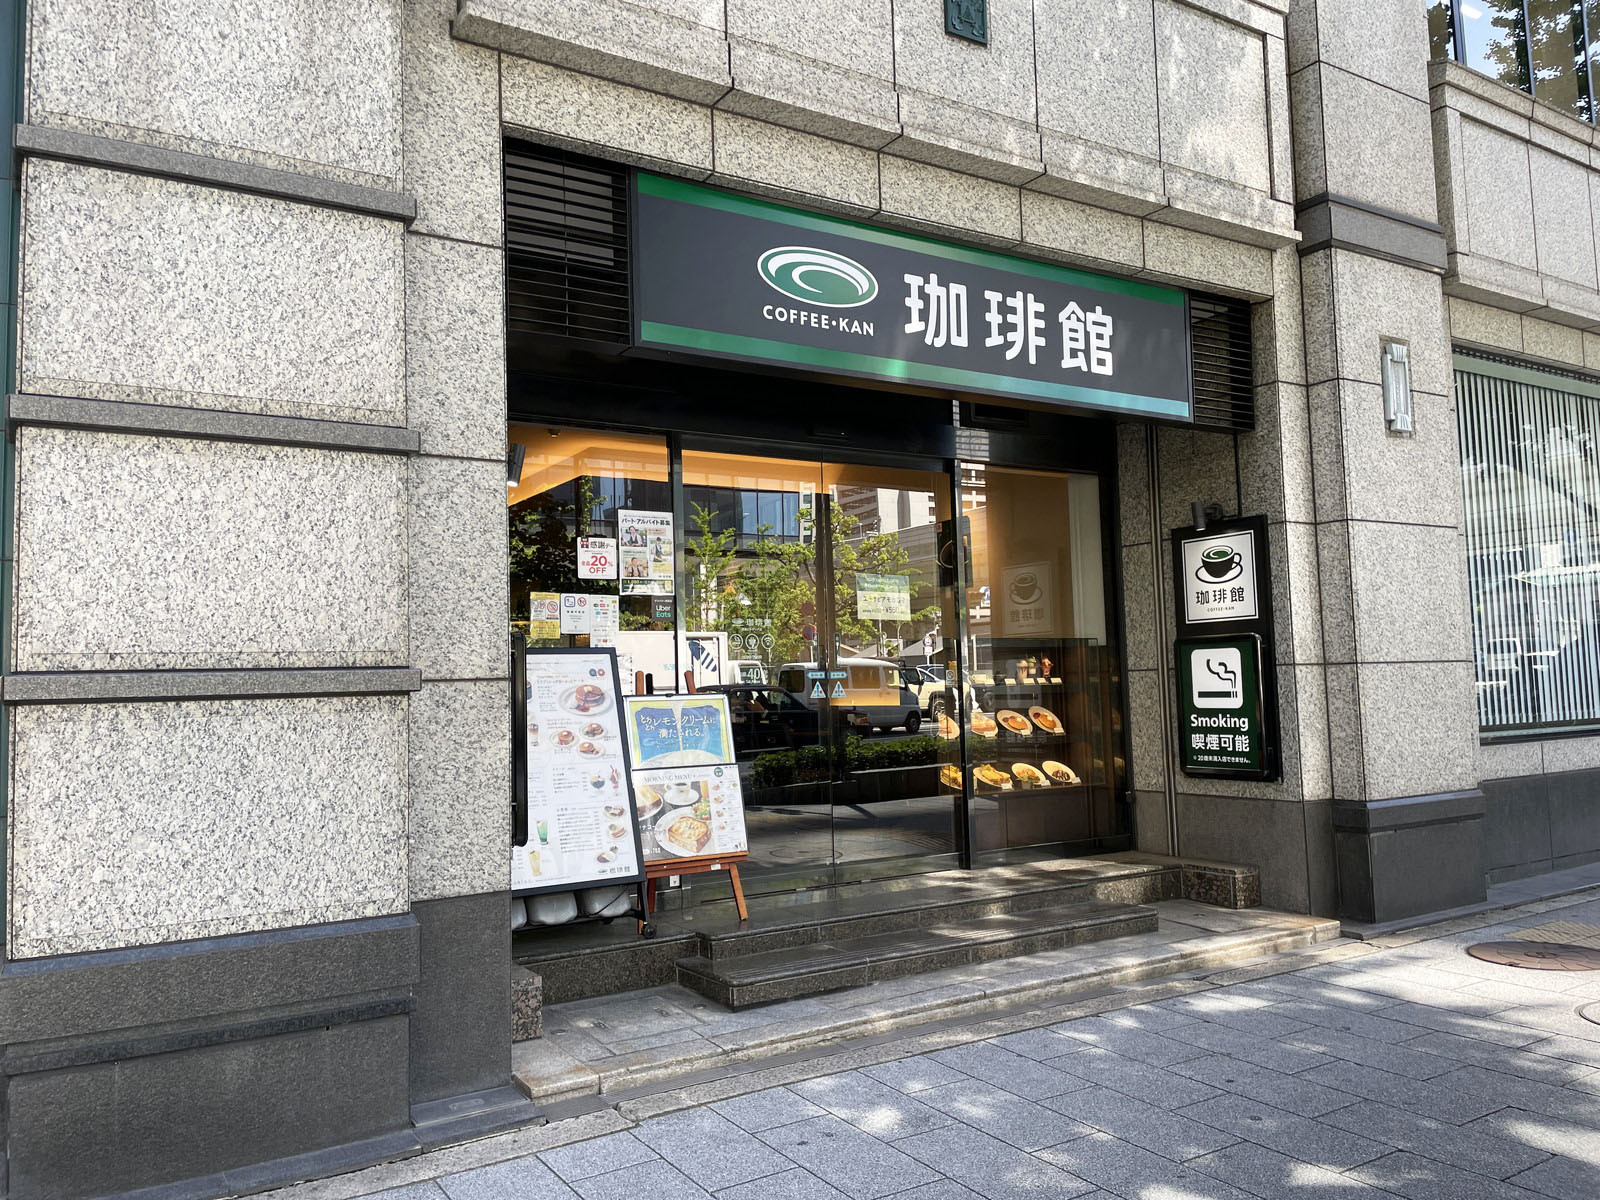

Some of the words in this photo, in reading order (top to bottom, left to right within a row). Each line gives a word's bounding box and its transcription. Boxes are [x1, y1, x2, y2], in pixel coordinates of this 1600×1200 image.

[903, 273, 1113, 376] 珈琲館
[588, 566, 607, 574] OFF
[1195, 586, 1245, 605] 珈琲館
[655, 604, 672, 612] Uber
[1190, 713, 1249, 731] Smoking
[1191, 733, 1250, 752] 喫煙可能
